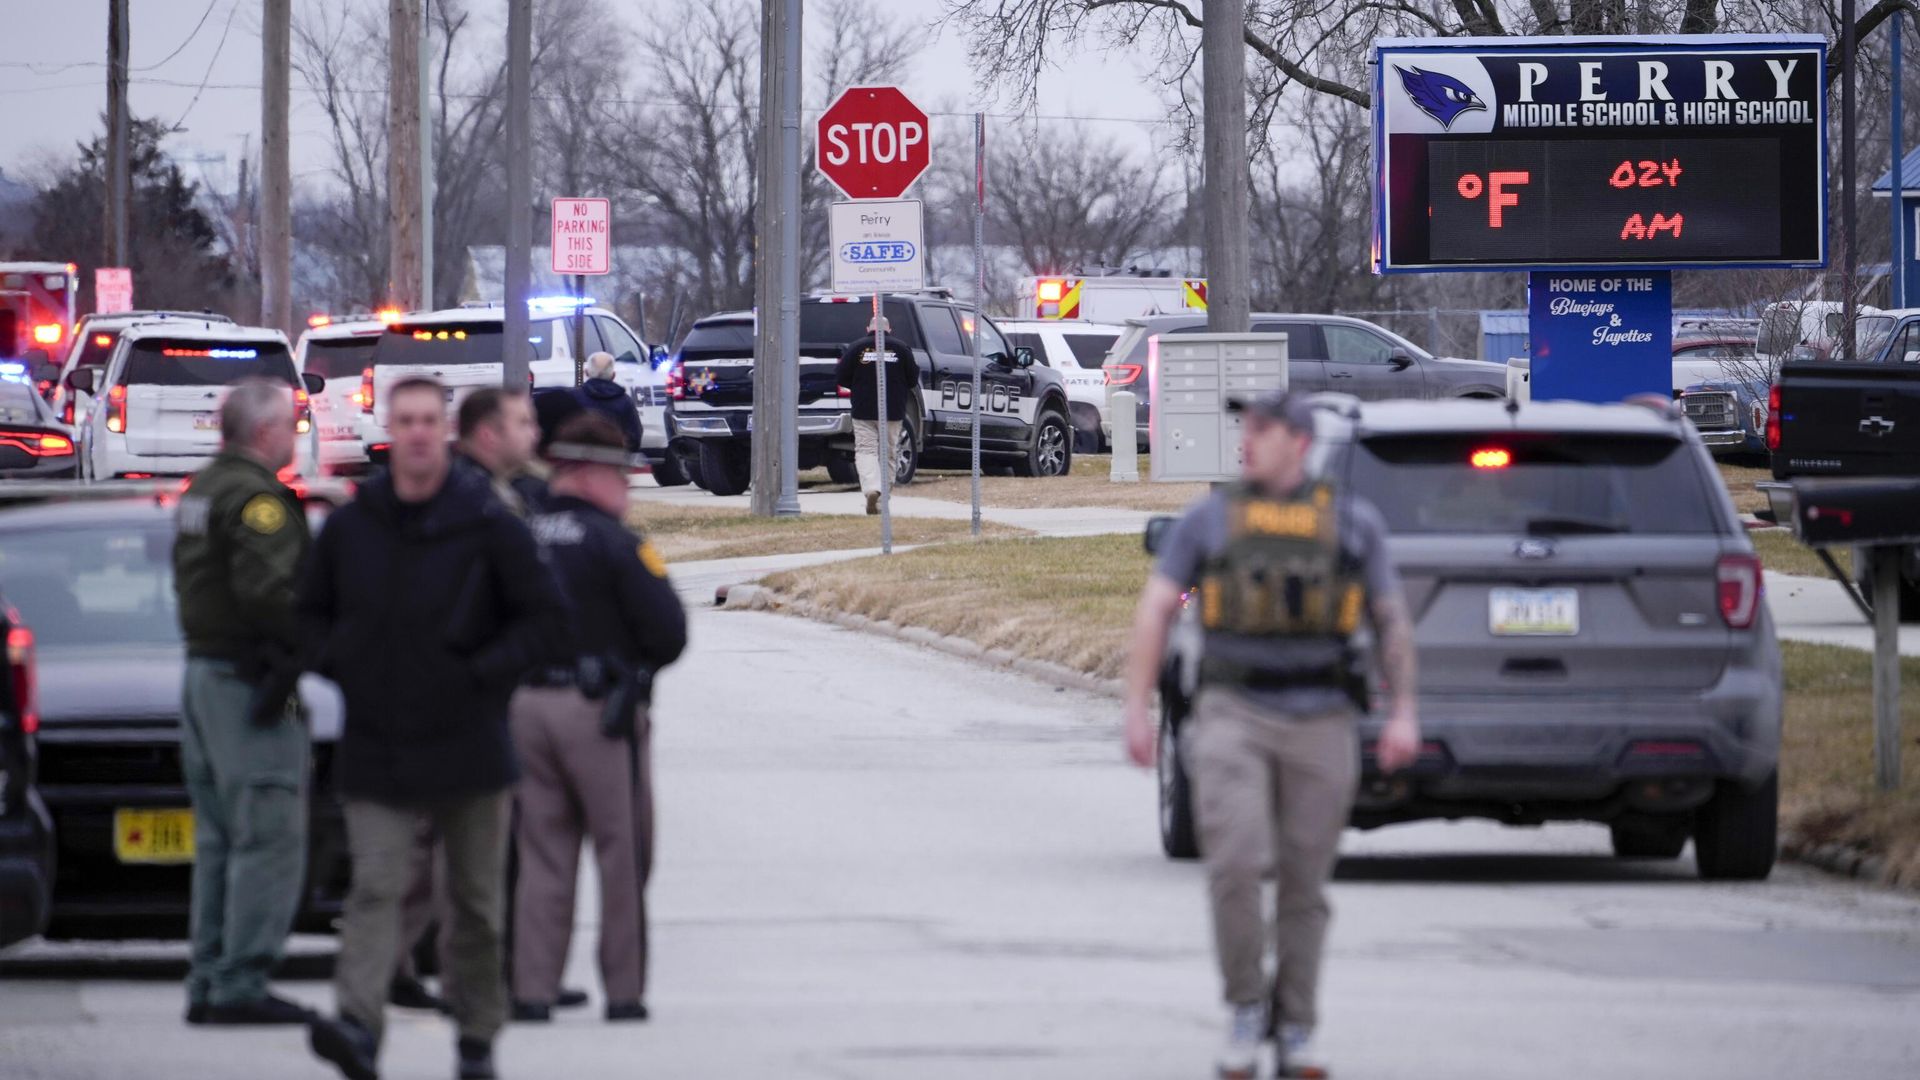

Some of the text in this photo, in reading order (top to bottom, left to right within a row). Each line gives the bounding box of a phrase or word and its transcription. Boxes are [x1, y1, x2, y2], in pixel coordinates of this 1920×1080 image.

[1517, 59, 1799, 102] PERRY
[1503, 100, 1813, 127] MIDDLE SCHOOL & HIGH SCHOOL
[826, 121, 923, 166] STOP
[1609, 158, 1683, 189] 024
[573, 203, 587, 216] NO
[557, 220, 605, 233] PARKING
[861, 214, 891, 226] Perry
[1620, 212, 1684, 240] AM
[568, 237, 593, 251] THIS
[850, 244, 904, 260] SAFE
[567, 254, 593, 269] SIDE
[1550, 278, 1653, 292] HOME OF THE
[1550, 297, 1614, 317] Bluejays
[1610, 313, 1622, 327] &
[1592, 326, 1652, 346] Jayettes
